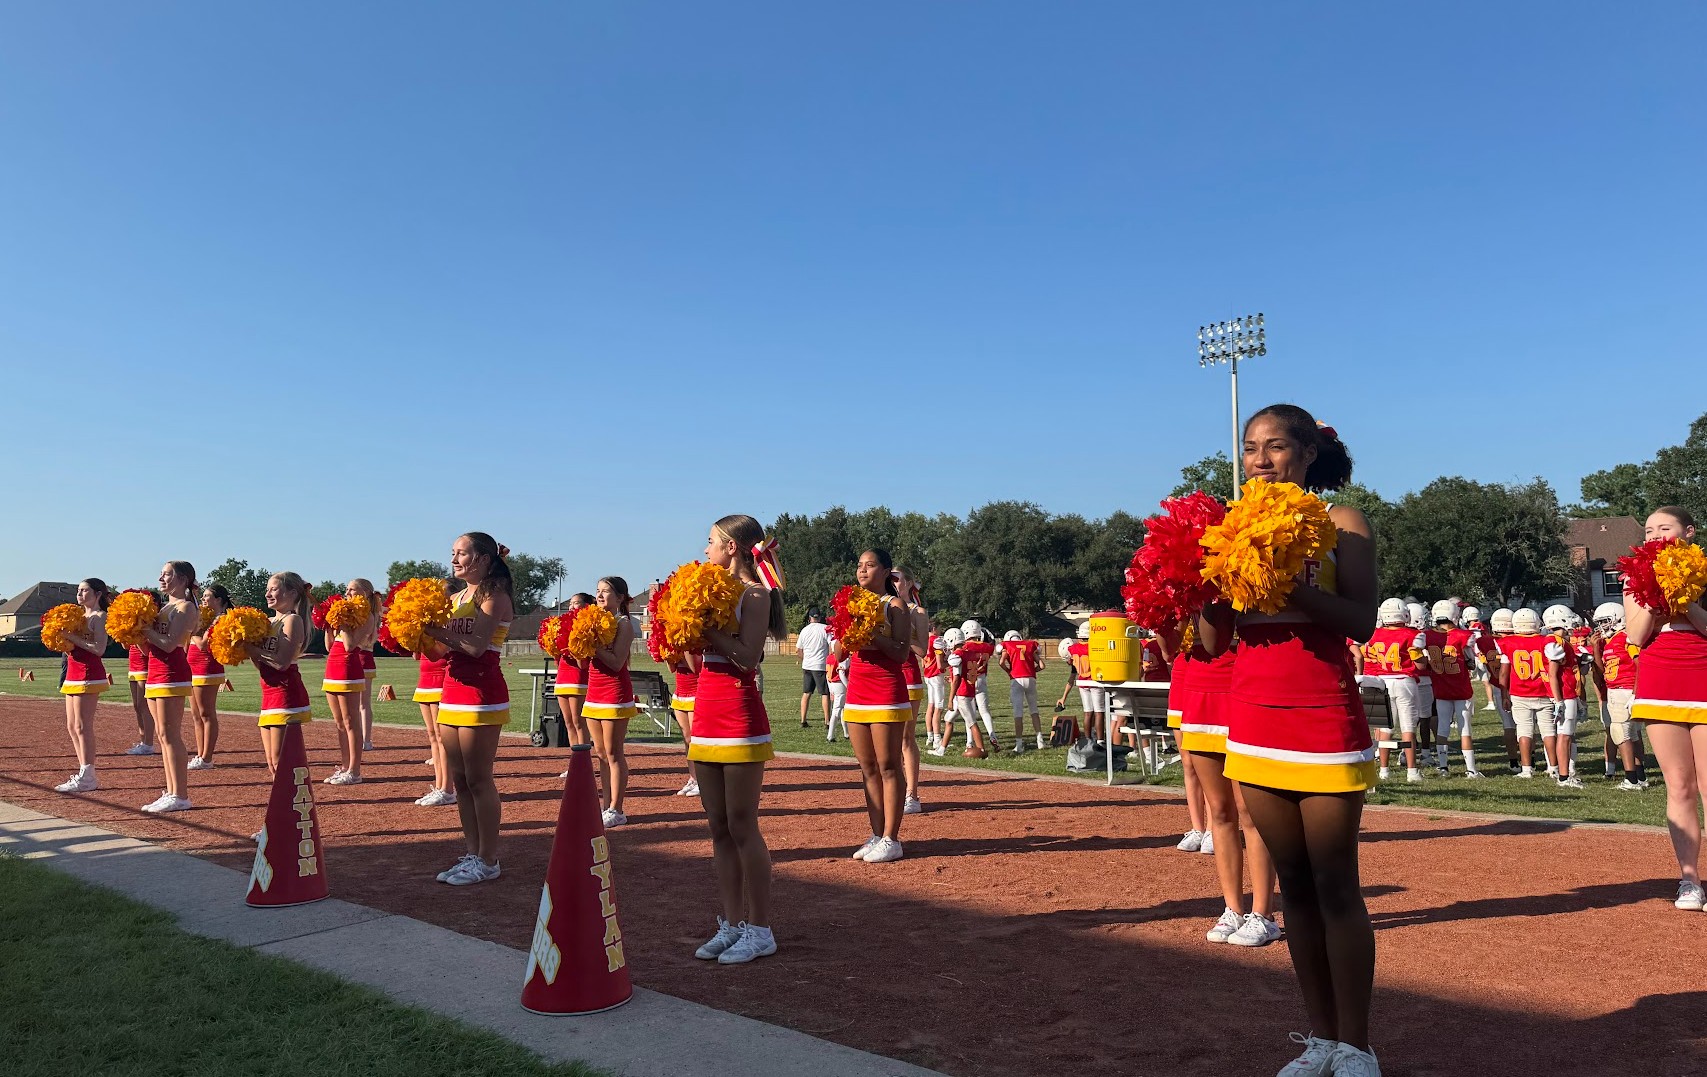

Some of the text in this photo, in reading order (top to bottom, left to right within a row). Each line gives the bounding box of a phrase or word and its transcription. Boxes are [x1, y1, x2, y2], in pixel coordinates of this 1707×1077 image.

[450, 617, 475, 635] RRE
[1090, 622, 1107, 634] igloo
[1015, 644, 1027, 661] 7
[1050, 719, 1073, 748] 50
[292, 766, 318, 877] PAYTON
[590, 835, 626, 973] DYLAN
